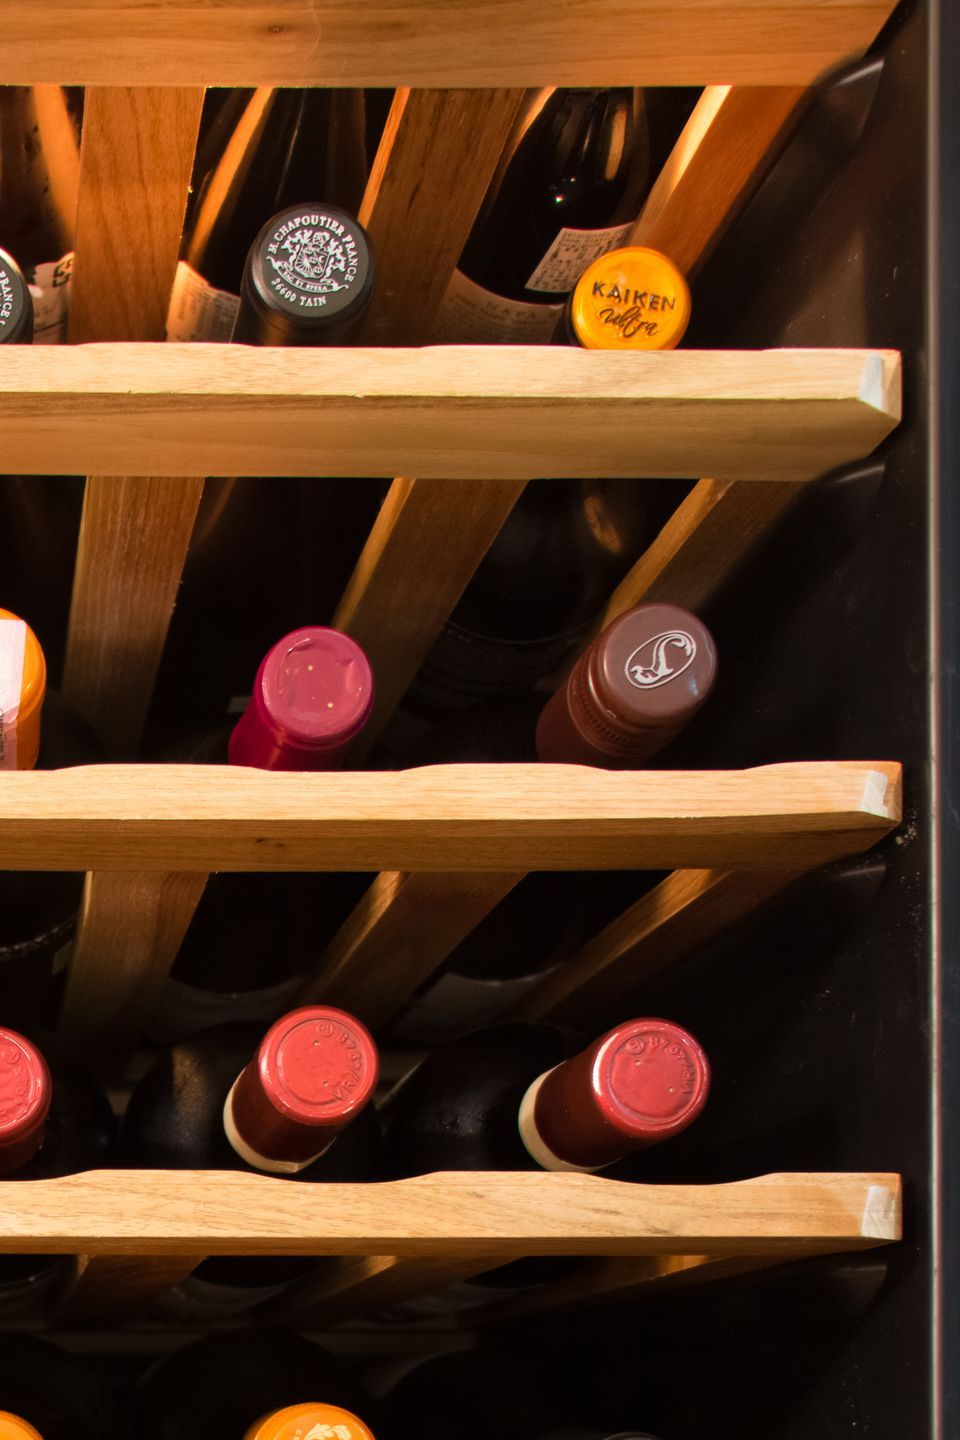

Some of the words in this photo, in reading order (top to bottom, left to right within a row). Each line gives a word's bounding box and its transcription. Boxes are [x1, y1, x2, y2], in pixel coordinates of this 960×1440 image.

[274, 215, 345, 242] CHAPOUTIER
[342, 235, 359, 283] FRANCE
[300, 296, 327, 307] TAIN
[592, 281, 676, 313] KAIKEN
[600, 306, 659, 338] Ultra
